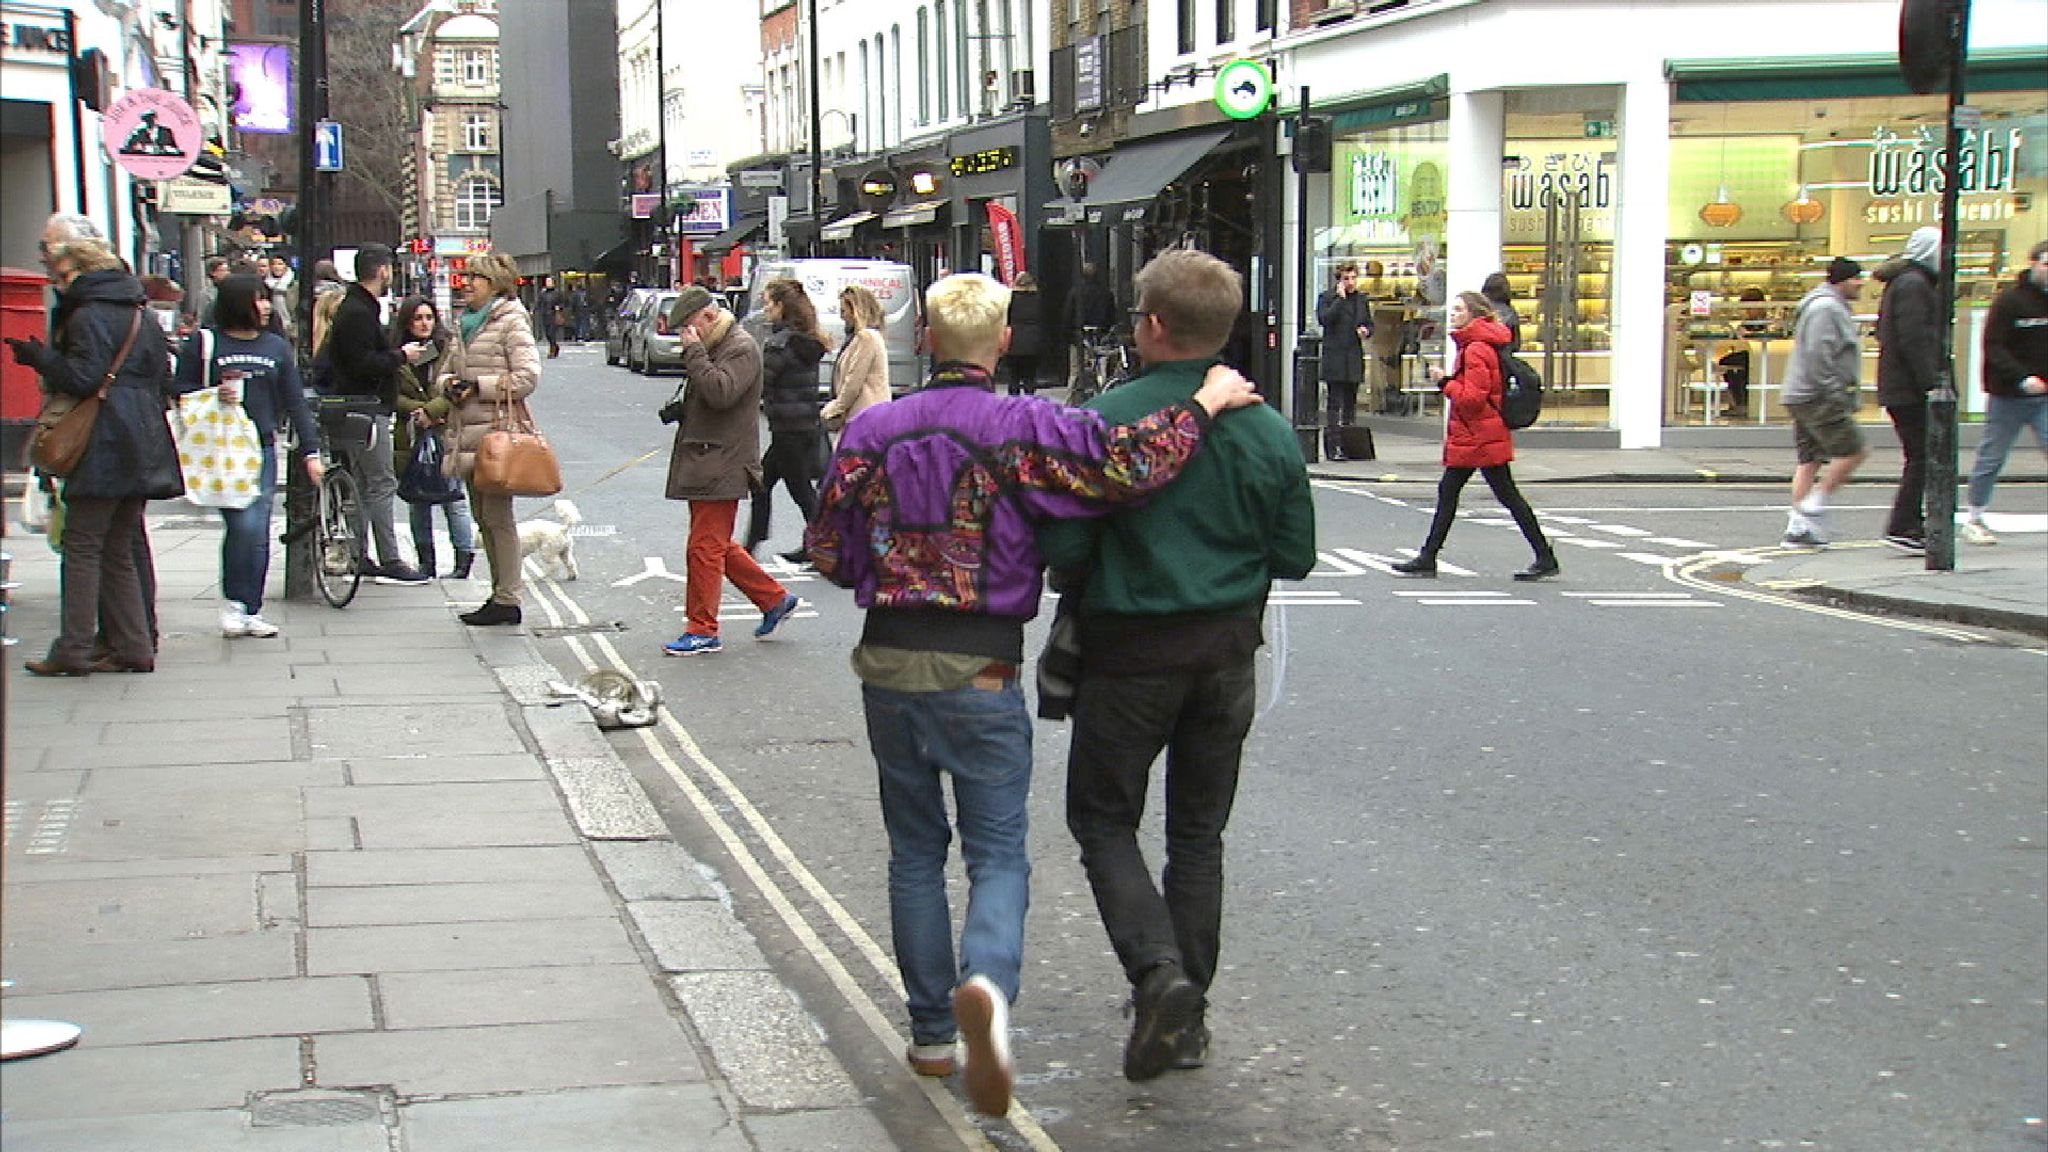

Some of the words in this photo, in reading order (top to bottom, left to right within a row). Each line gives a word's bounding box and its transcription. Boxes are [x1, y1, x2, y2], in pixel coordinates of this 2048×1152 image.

[1868, 129, 2024, 197] wasabi
[1866, 199, 1922, 224] sushi
[1957, 198, 2016, 221] bento
[837, 277, 903, 288] TECHNICAL
